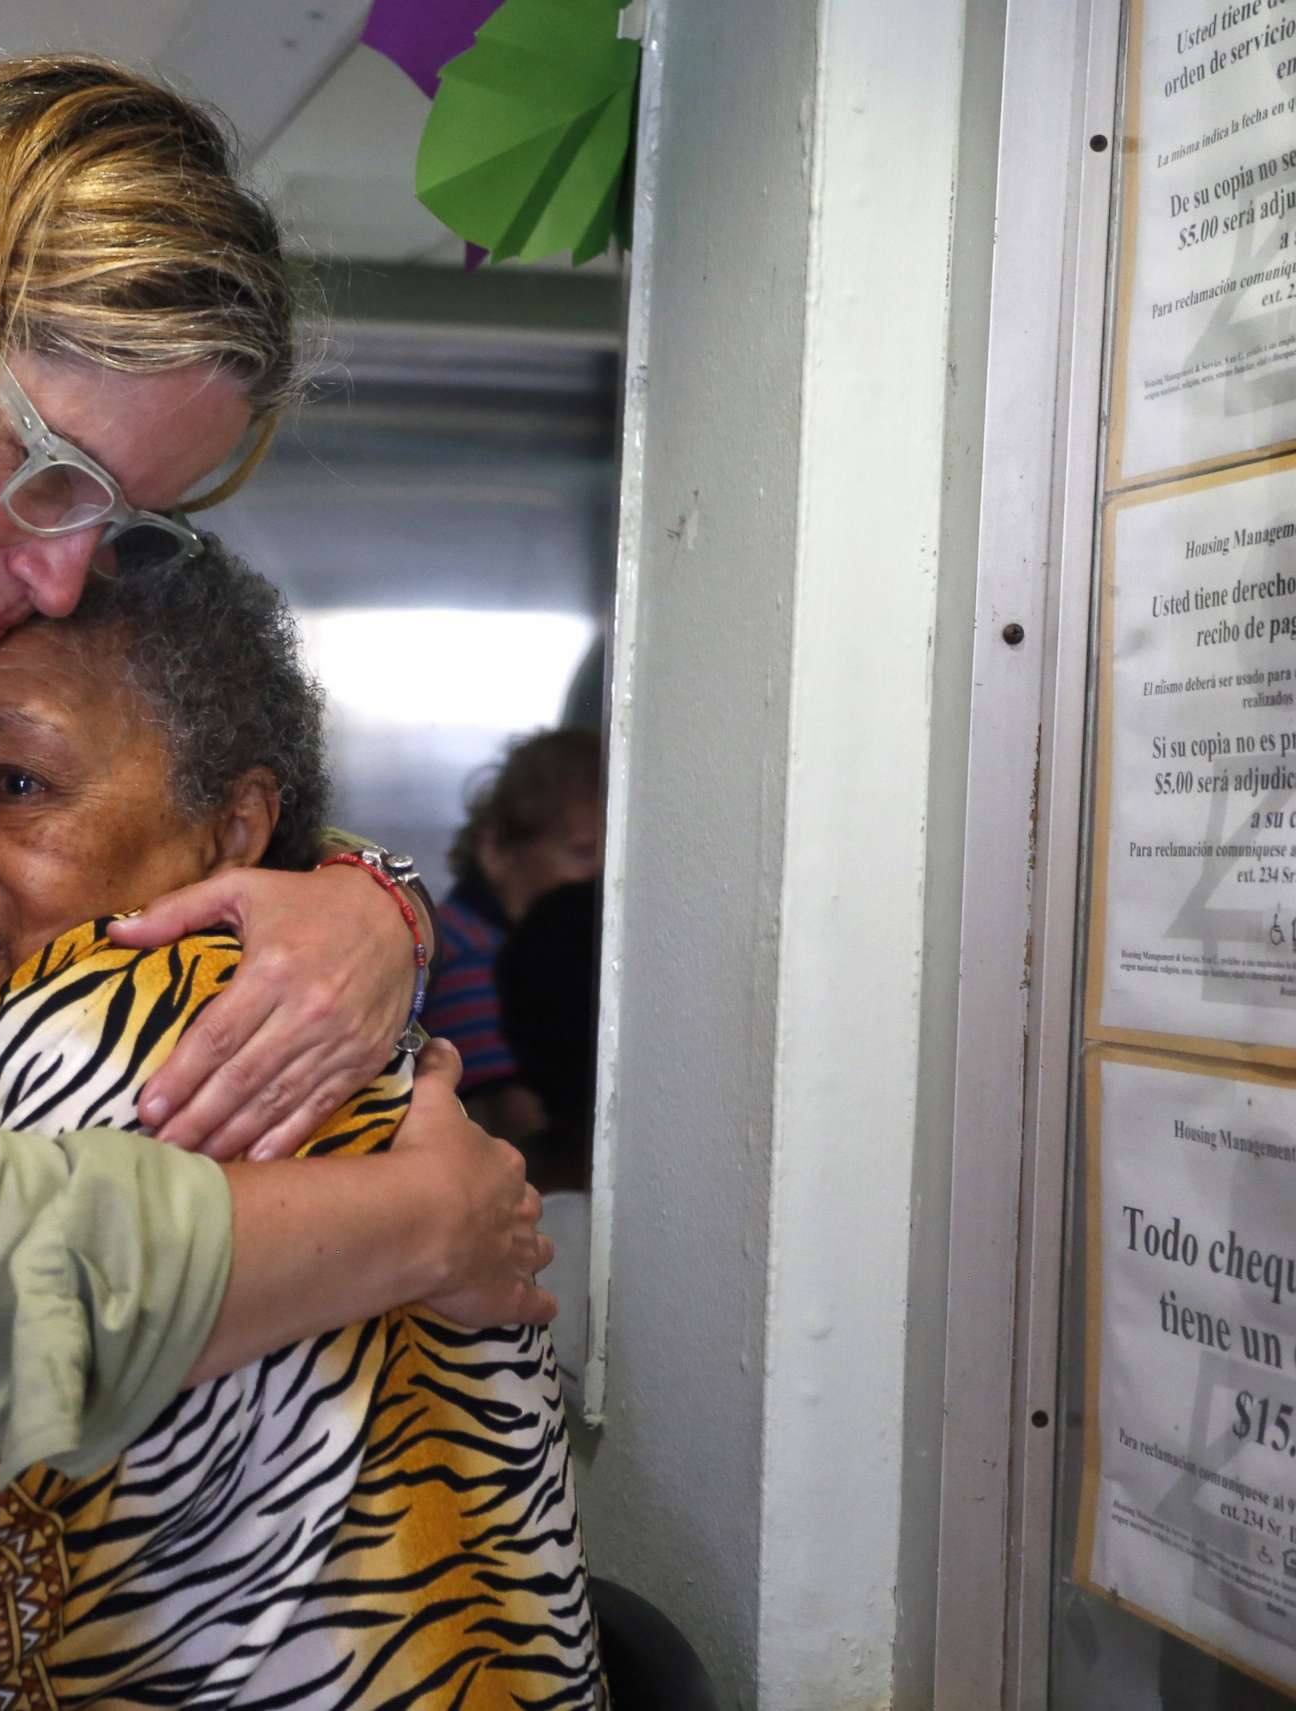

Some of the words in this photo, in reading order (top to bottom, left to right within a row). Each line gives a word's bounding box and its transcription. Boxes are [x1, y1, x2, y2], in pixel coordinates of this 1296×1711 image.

[1177, 14, 1217, 54] Usted
[1221, 0, 1261, 31] tiene
[1164, 65, 1206, 98] orden
[1210, 51, 1227, 75] de
[1157, 153, 1169, 168] La
[1171, 141, 1200, 162] misma
[1202, 126, 1230, 149] indica
[1231, 118, 1240, 133] la
[1242, 107, 1268, 128] fecha
[1272, 102, 1285, 116] en
[1170, 194, 1190, 218] De
[1194, 184, 1210, 208] su
[1214, 164, 1255, 200] copia
[1259, 158, 1278, 182] no
[1178, 214, 1219, 250] $5.00
[1223, 199, 1255, 233] será
[1279, 232, 1289, 250] a
[1152, 300, 1173, 320] Para
[1175, 278, 1237, 310] reclamación
[1262, 289, 1283, 306] ext.
[1185, 536, 1230, 559] Housing
[1233, 523, 1296, 549] Managem
[1152, 590, 1190, 617] Usted
[1194, 587, 1228, 611] tiene
[1232, 572, 1296, 604] derecho
[1197, 620, 1240, 647] recibo
[1245, 615, 1265, 639] de
[1143, 682, 1153, 696] El
[1155, 679, 1183, 695] mismo
[1185, 673, 1216, 692] deberá
[1219, 674, 1233, 688] ser
[1236, 669, 1264, 685] usado
[1268, 669, 1292, 687] para
[1243, 690, 1294, 709] realizados
[1152, 736, 1167, 759] Si
[1170, 741, 1186, 758] su
[1191, 732, 1231, 762] copia
[1236, 736, 1255, 752] no
[1260, 734, 1276, 751] es
[1154, 771, 1193, 795] $5.00
[1198, 769, 1229, 793] será
[1251, 811, 1260, 829] a
[1265, 810, 1284, 829] su
[1130, 842, 1152, 857] Para
[1155, 841, 1213, 857] reclamación
[1237, 869, 1256, 883] ext.
[1259, 866, 1278, 883] 234
[1174, 1119, 1217, 1151] Housing
[1220, 1129, 1296, 1162] Management
[1123, 1205, 1198, 1267] Todo
[1160, 1290, 1231, 1351] tiene
[1241, 1325, 1282, 1369] un
[1119, 1427, 1139, 1450] Para
[1273, 1496, 1284, 1512] al
[1244, 1507, 1264, 1531] 234
